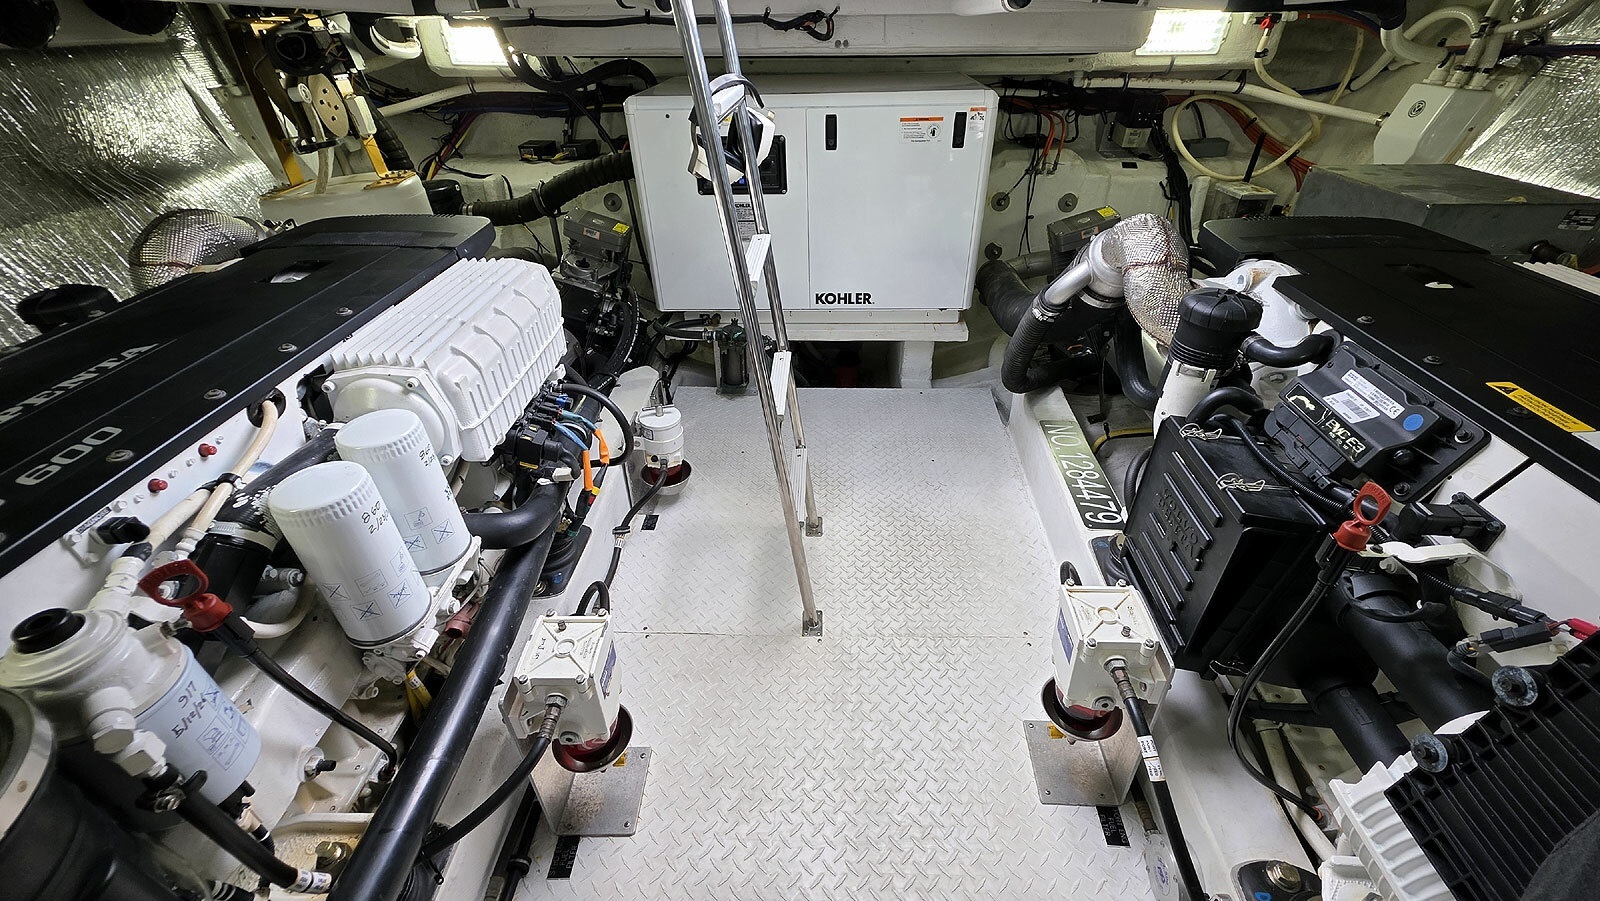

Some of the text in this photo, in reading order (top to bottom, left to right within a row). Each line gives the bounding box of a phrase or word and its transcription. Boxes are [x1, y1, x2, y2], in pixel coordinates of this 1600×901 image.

[0, 343, 159, 424] PENTA
[1045, 424, 1082, 450] NO.
[15, 426, 123, 486] 600
[1100, 814, 1111, 837] FILTER
[1108, 817, 1117, 834] FUEL
[559, 849, 570, 866] FUEL
[566, 845, 577, 869] FILTER
